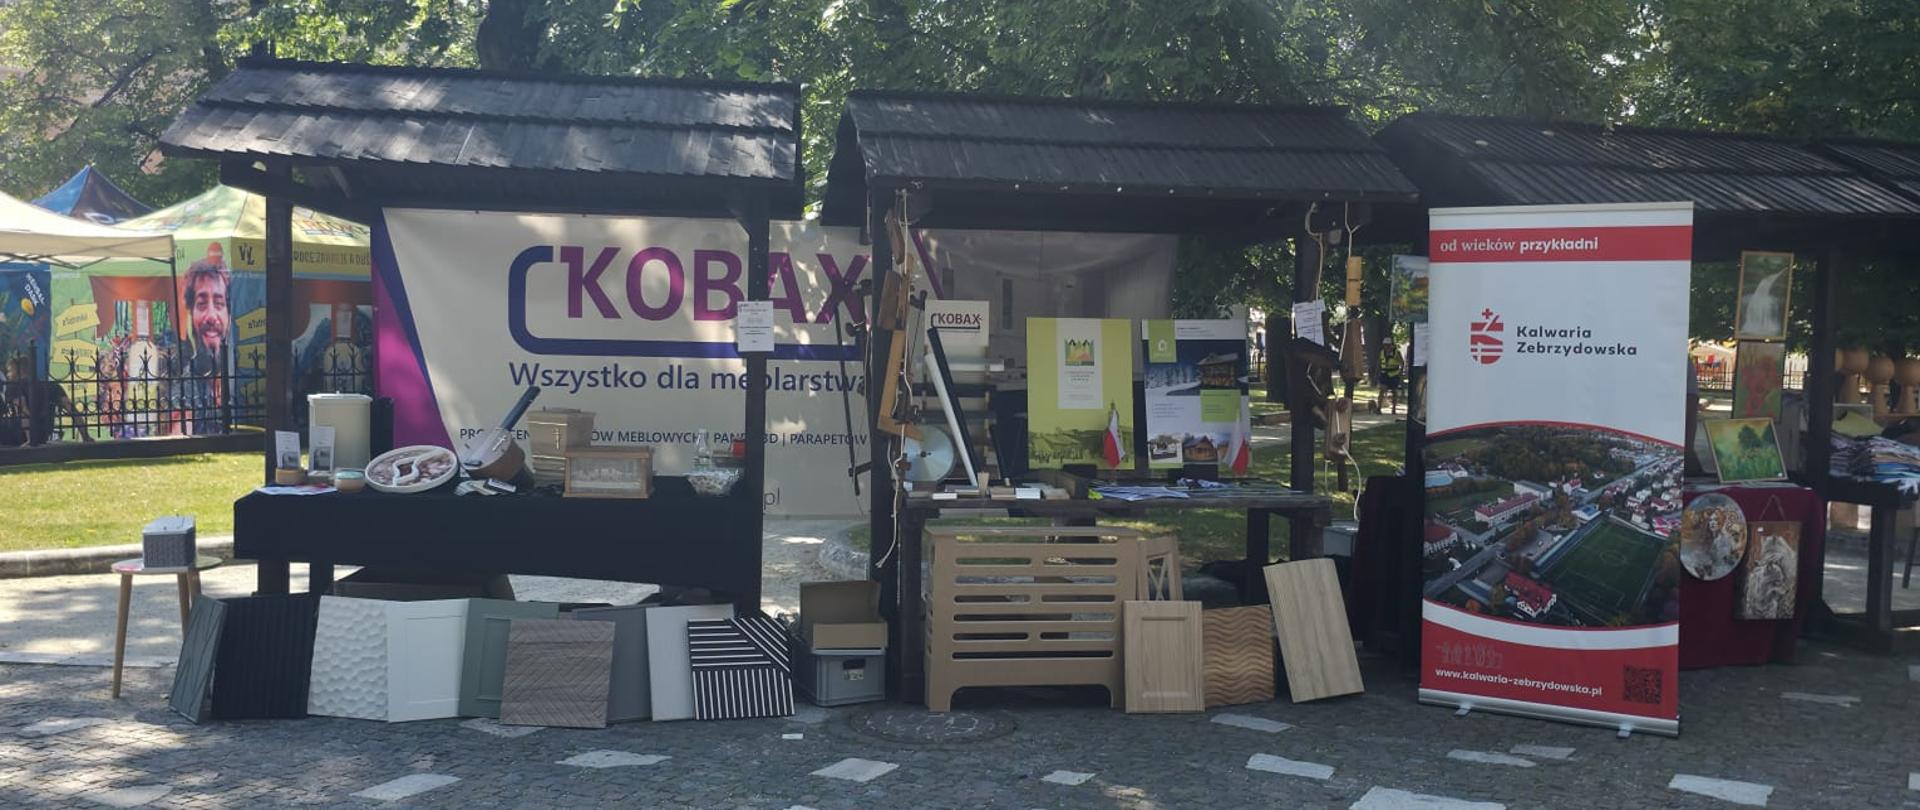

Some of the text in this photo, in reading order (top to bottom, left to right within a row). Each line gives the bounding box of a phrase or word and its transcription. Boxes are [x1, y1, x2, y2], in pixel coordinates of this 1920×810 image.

[1440, 237, 1598, 254] od wieków przykładni
[560, 246, 870, 324] KOBAX
[937, 313, 980, 325] KOBAX
[1516, 326, 1592, 339] Kalwaria
[1516, 342, 1637, 357] Zebrzydowska
[509, 362, 647, 394] Wszystko
[657, 364, 699, 389] dla
[1435, 668, 1603, 697] www.kalwaria-zebrzydowska.pl
